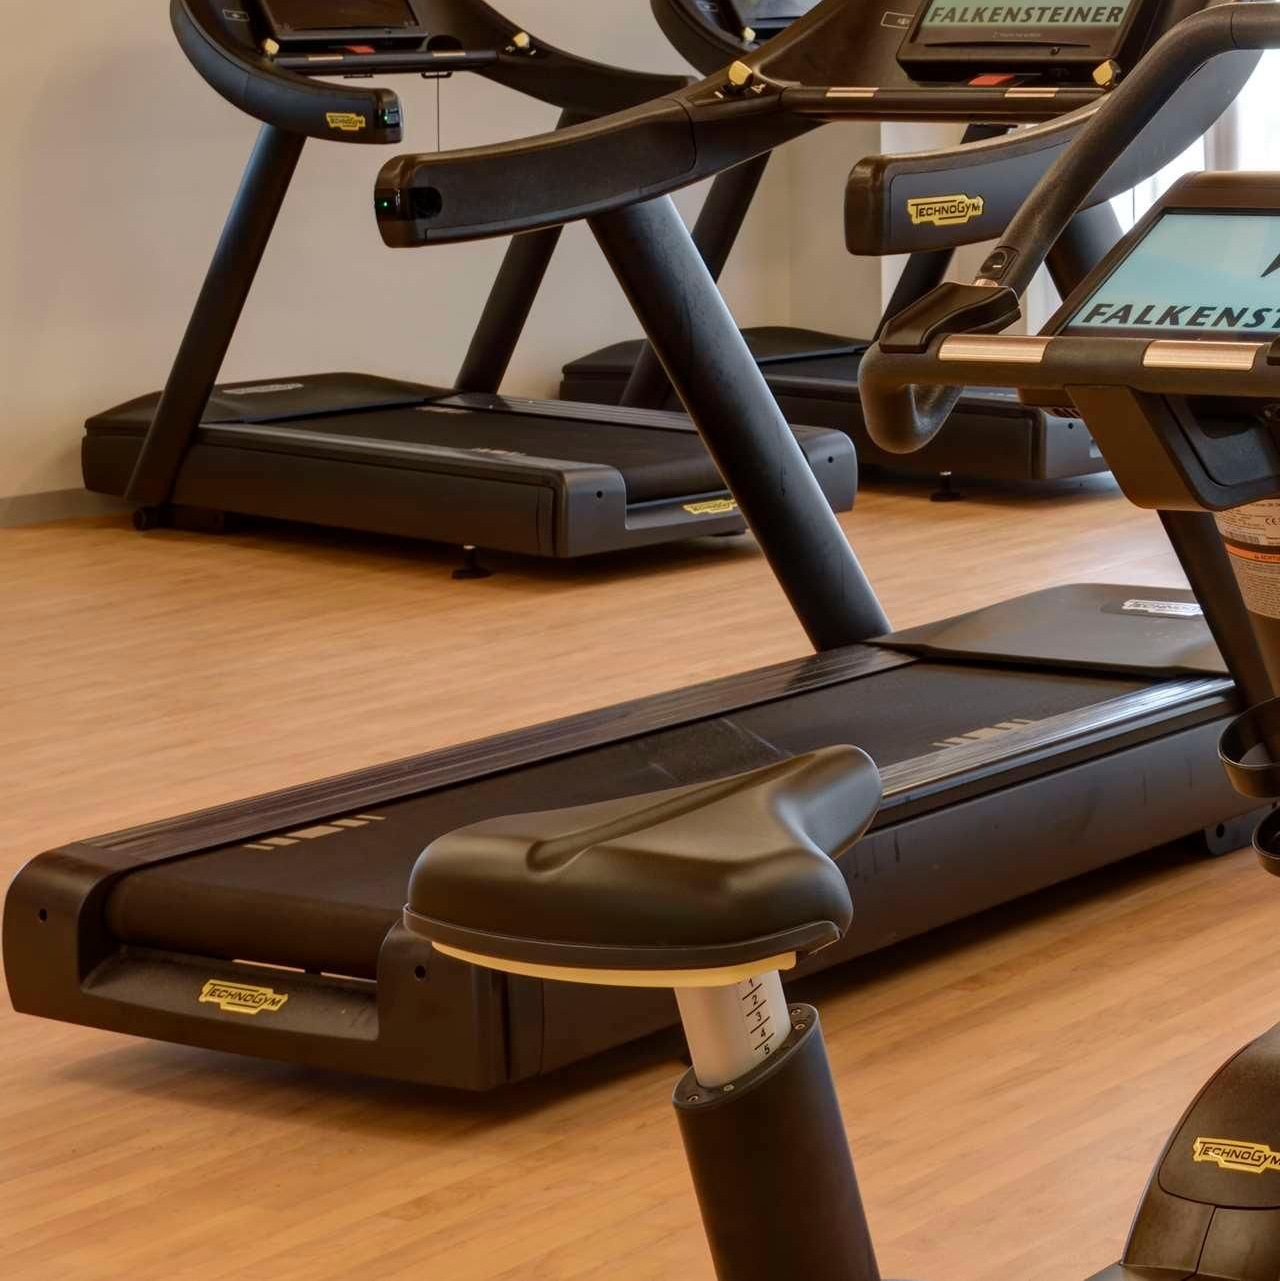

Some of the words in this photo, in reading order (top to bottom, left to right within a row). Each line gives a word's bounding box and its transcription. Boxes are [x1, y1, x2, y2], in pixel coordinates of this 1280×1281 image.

[928, 5, 1125, 24] FALKENSTEINER
[909, 198, 981, 221] TECHNOGYM
[203, 982, 281, 1009] TECHNOGYM
